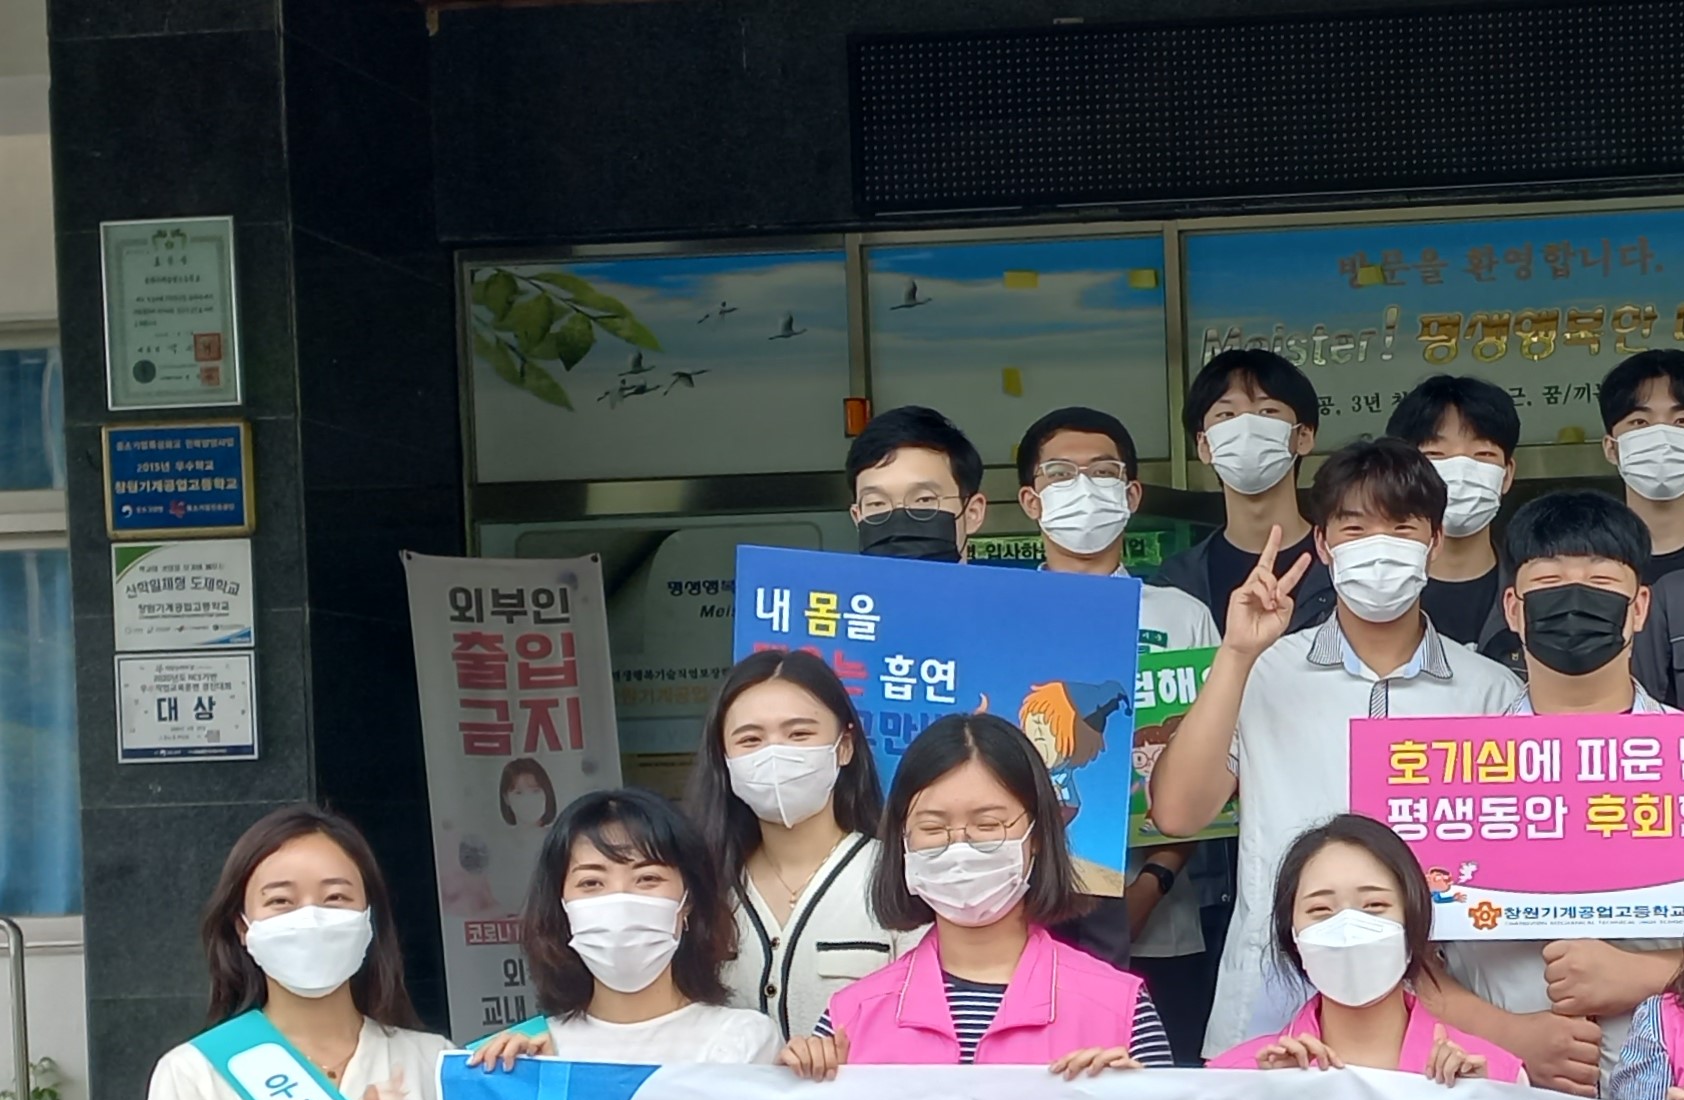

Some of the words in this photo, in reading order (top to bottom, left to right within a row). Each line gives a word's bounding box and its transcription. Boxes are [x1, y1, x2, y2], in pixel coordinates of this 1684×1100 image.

[1463, 235, 1665, 282] 환영합니다.
[1416, 303, 1659, 364] 평생행복한
[1352, 393, 1382, 413] 3년
[1542, 383, 1600, 405] 꿈/끼
[449, 586, 571, 625] 외부인
[756, 587, 790, 633] 내
[804, 591, 881, 641] 몸을
[451, 631, 578, 690] 출입
[880, 654, 956, 704] 흡연
[458, 696, 584, 756] 금지
[1387, 738, 1561, 785] 호기심에
[1577, 736, 1663, 782] 피운
[1387, 796, 1568, 841] 평생동안
[468, 923, 520, 943] 코로나1
